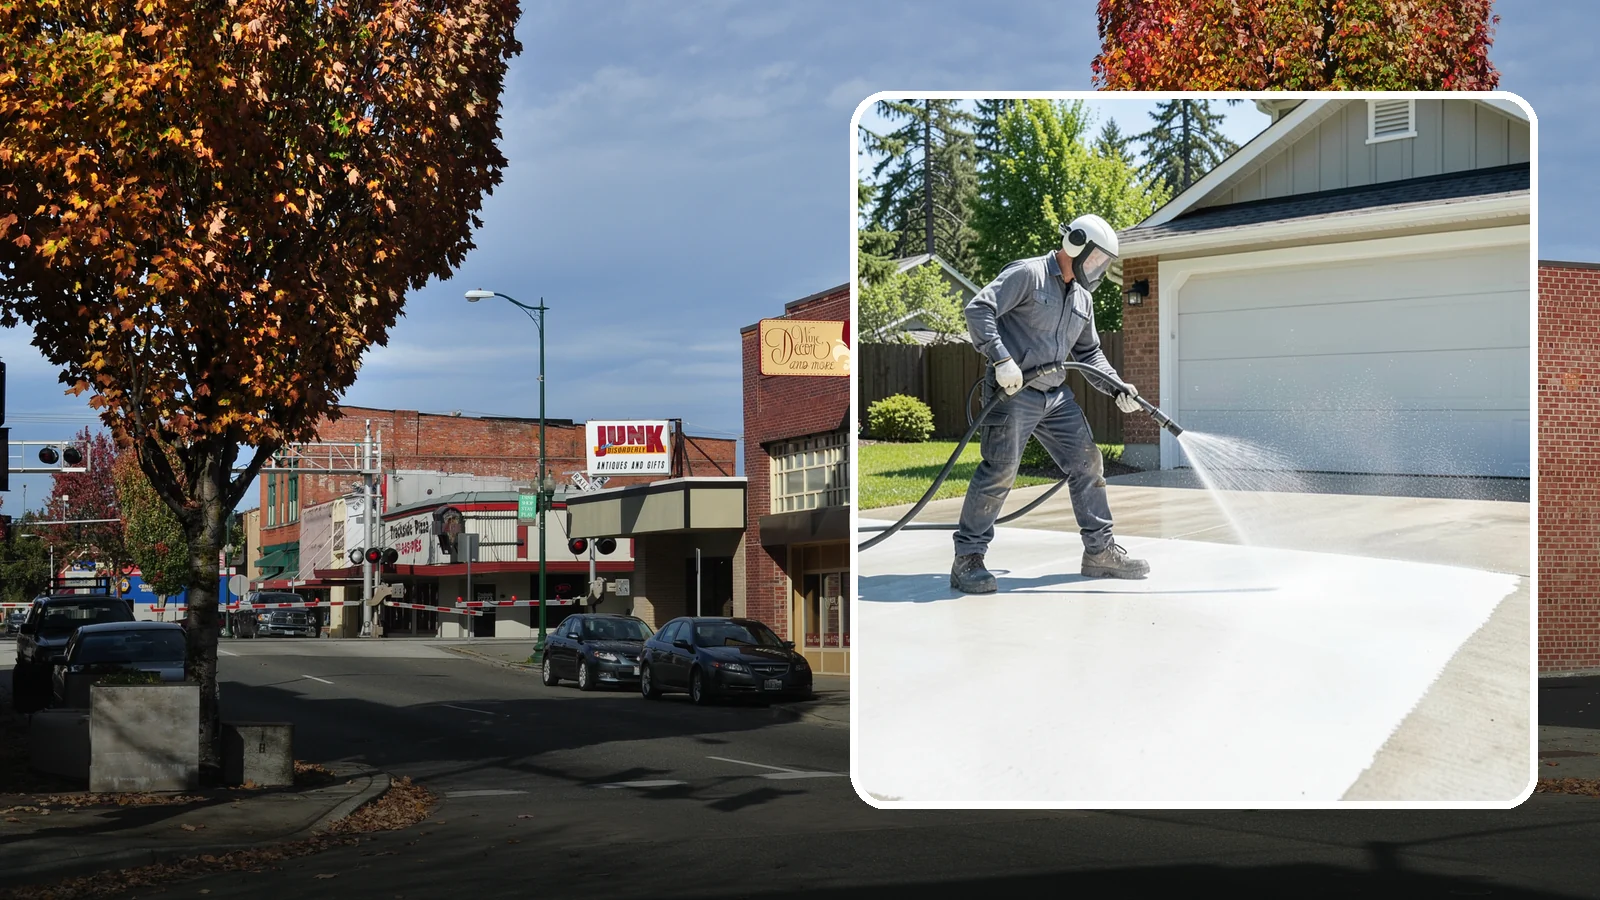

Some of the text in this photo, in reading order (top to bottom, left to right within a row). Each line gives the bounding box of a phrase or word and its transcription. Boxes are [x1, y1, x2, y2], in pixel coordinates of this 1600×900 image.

[765, 328, 831, 365] Decor
[596, 425, 665, 457] JUNK
[608, 446, 646, 454] DISORDERLY
[597, 460, 665, 470] ANTIQUES AND GIFTS
[390, 519, 429, 540] Trackside Pizza
